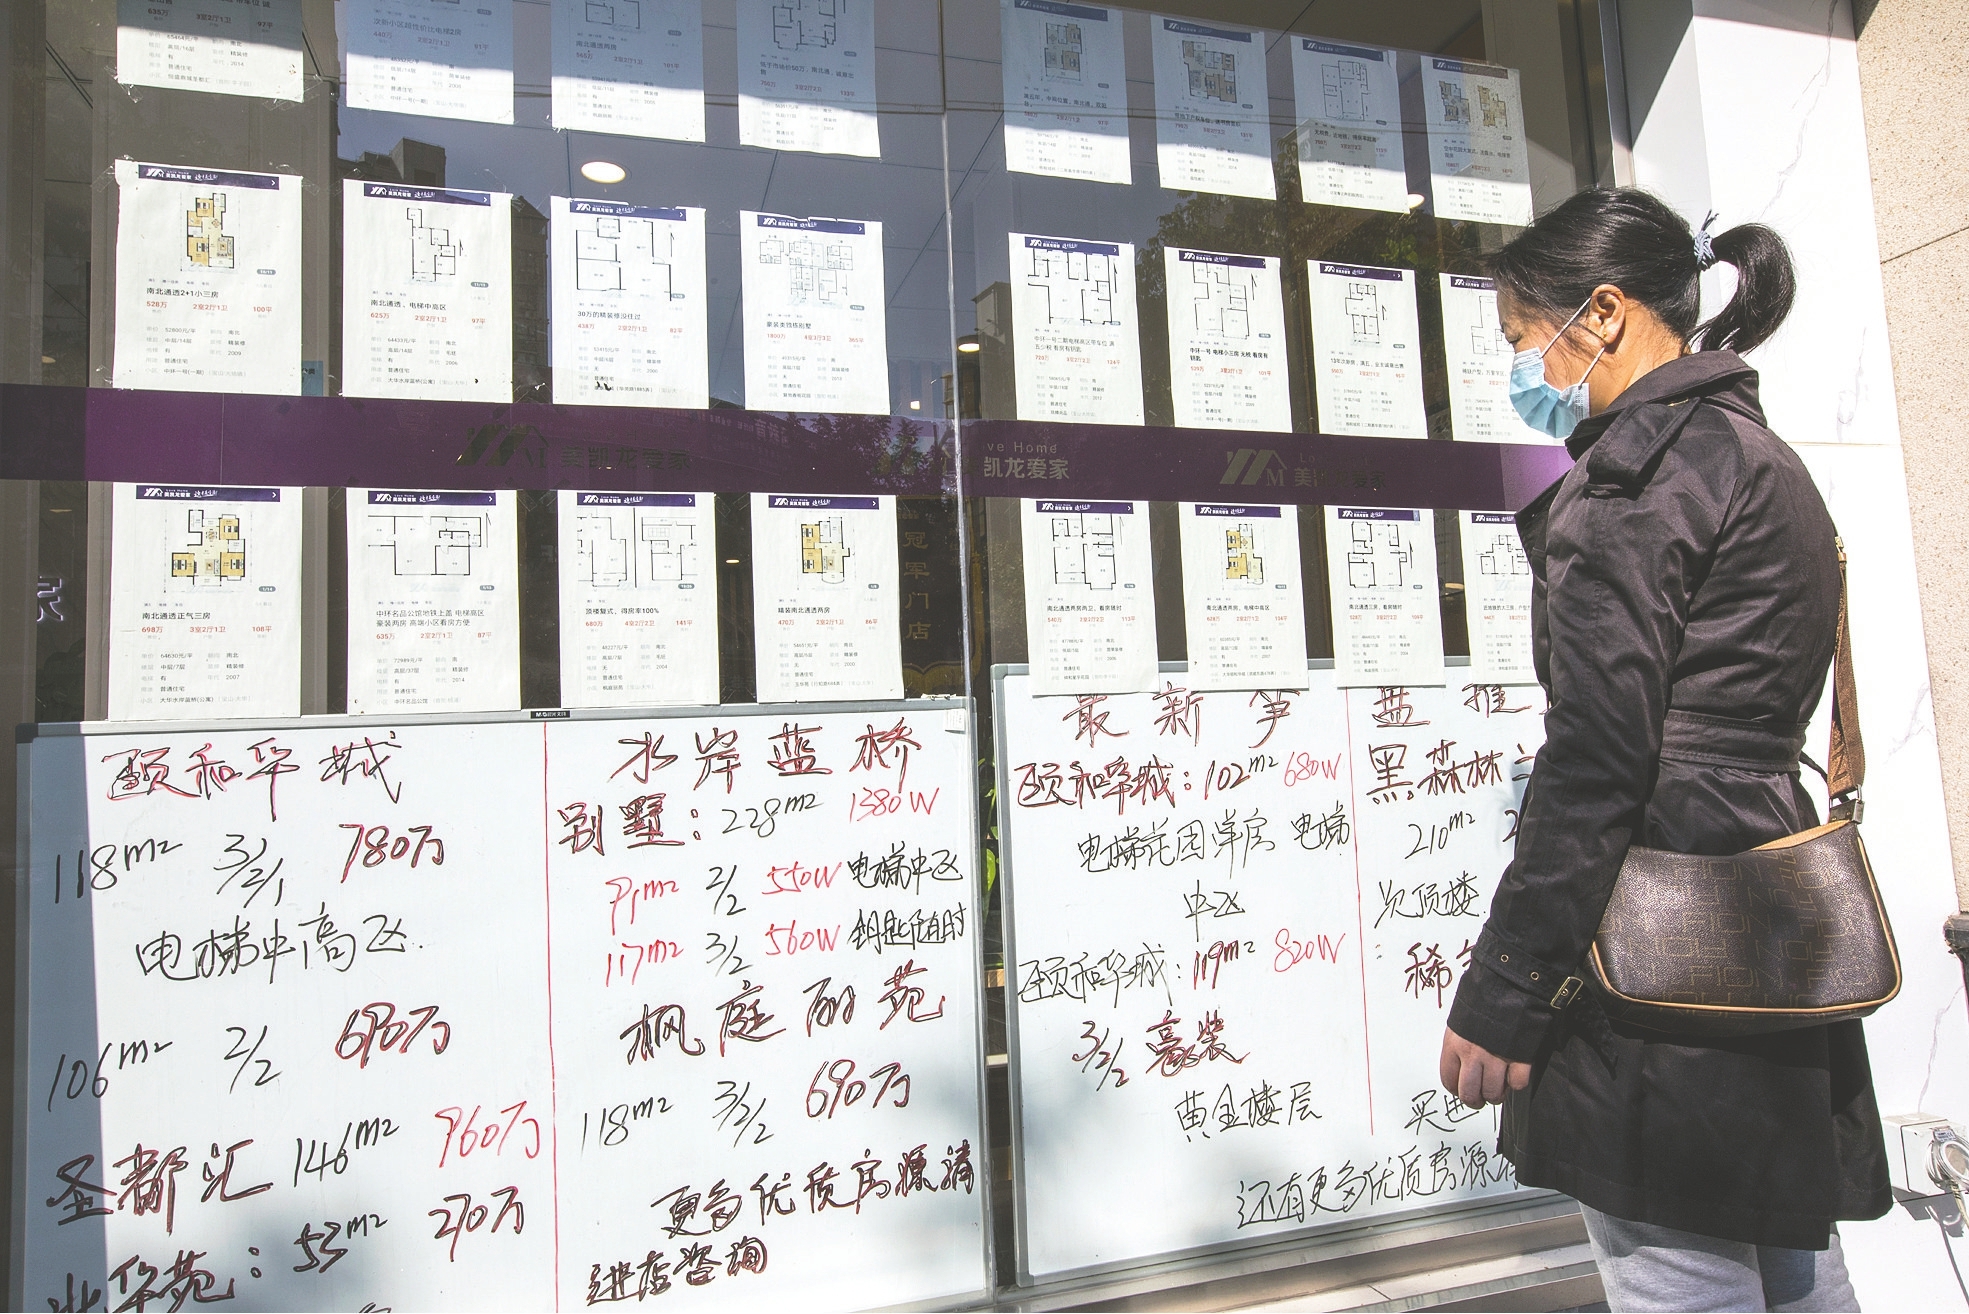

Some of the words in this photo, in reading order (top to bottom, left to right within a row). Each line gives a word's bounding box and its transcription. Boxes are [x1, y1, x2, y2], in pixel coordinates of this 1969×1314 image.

[146, 288, 218, 298] 南北通透2+1小三房
[146, 301, 167, 309] 528万
[193, 304, 228, 312] 2室2厅1卫
[415, 315, 447, 323] 2室2厅1卫
[1014, 441, 1057, 453] Home
[983, 456, 1070, 480] 凯龙爱家
[902, 531, 932, 640] 冠军门店
[142, 612, 211, 620] 南北通透正气三房
[607, 716, 922, 795] 水岸蓝桥
[339, 823, 445, 883] 780万
[1175, 1079, 1322, 1142] 黄金楼层
[46, 1139, 273, 1235] 圣都汇
[435, 1101, 542, 1167] 960万
